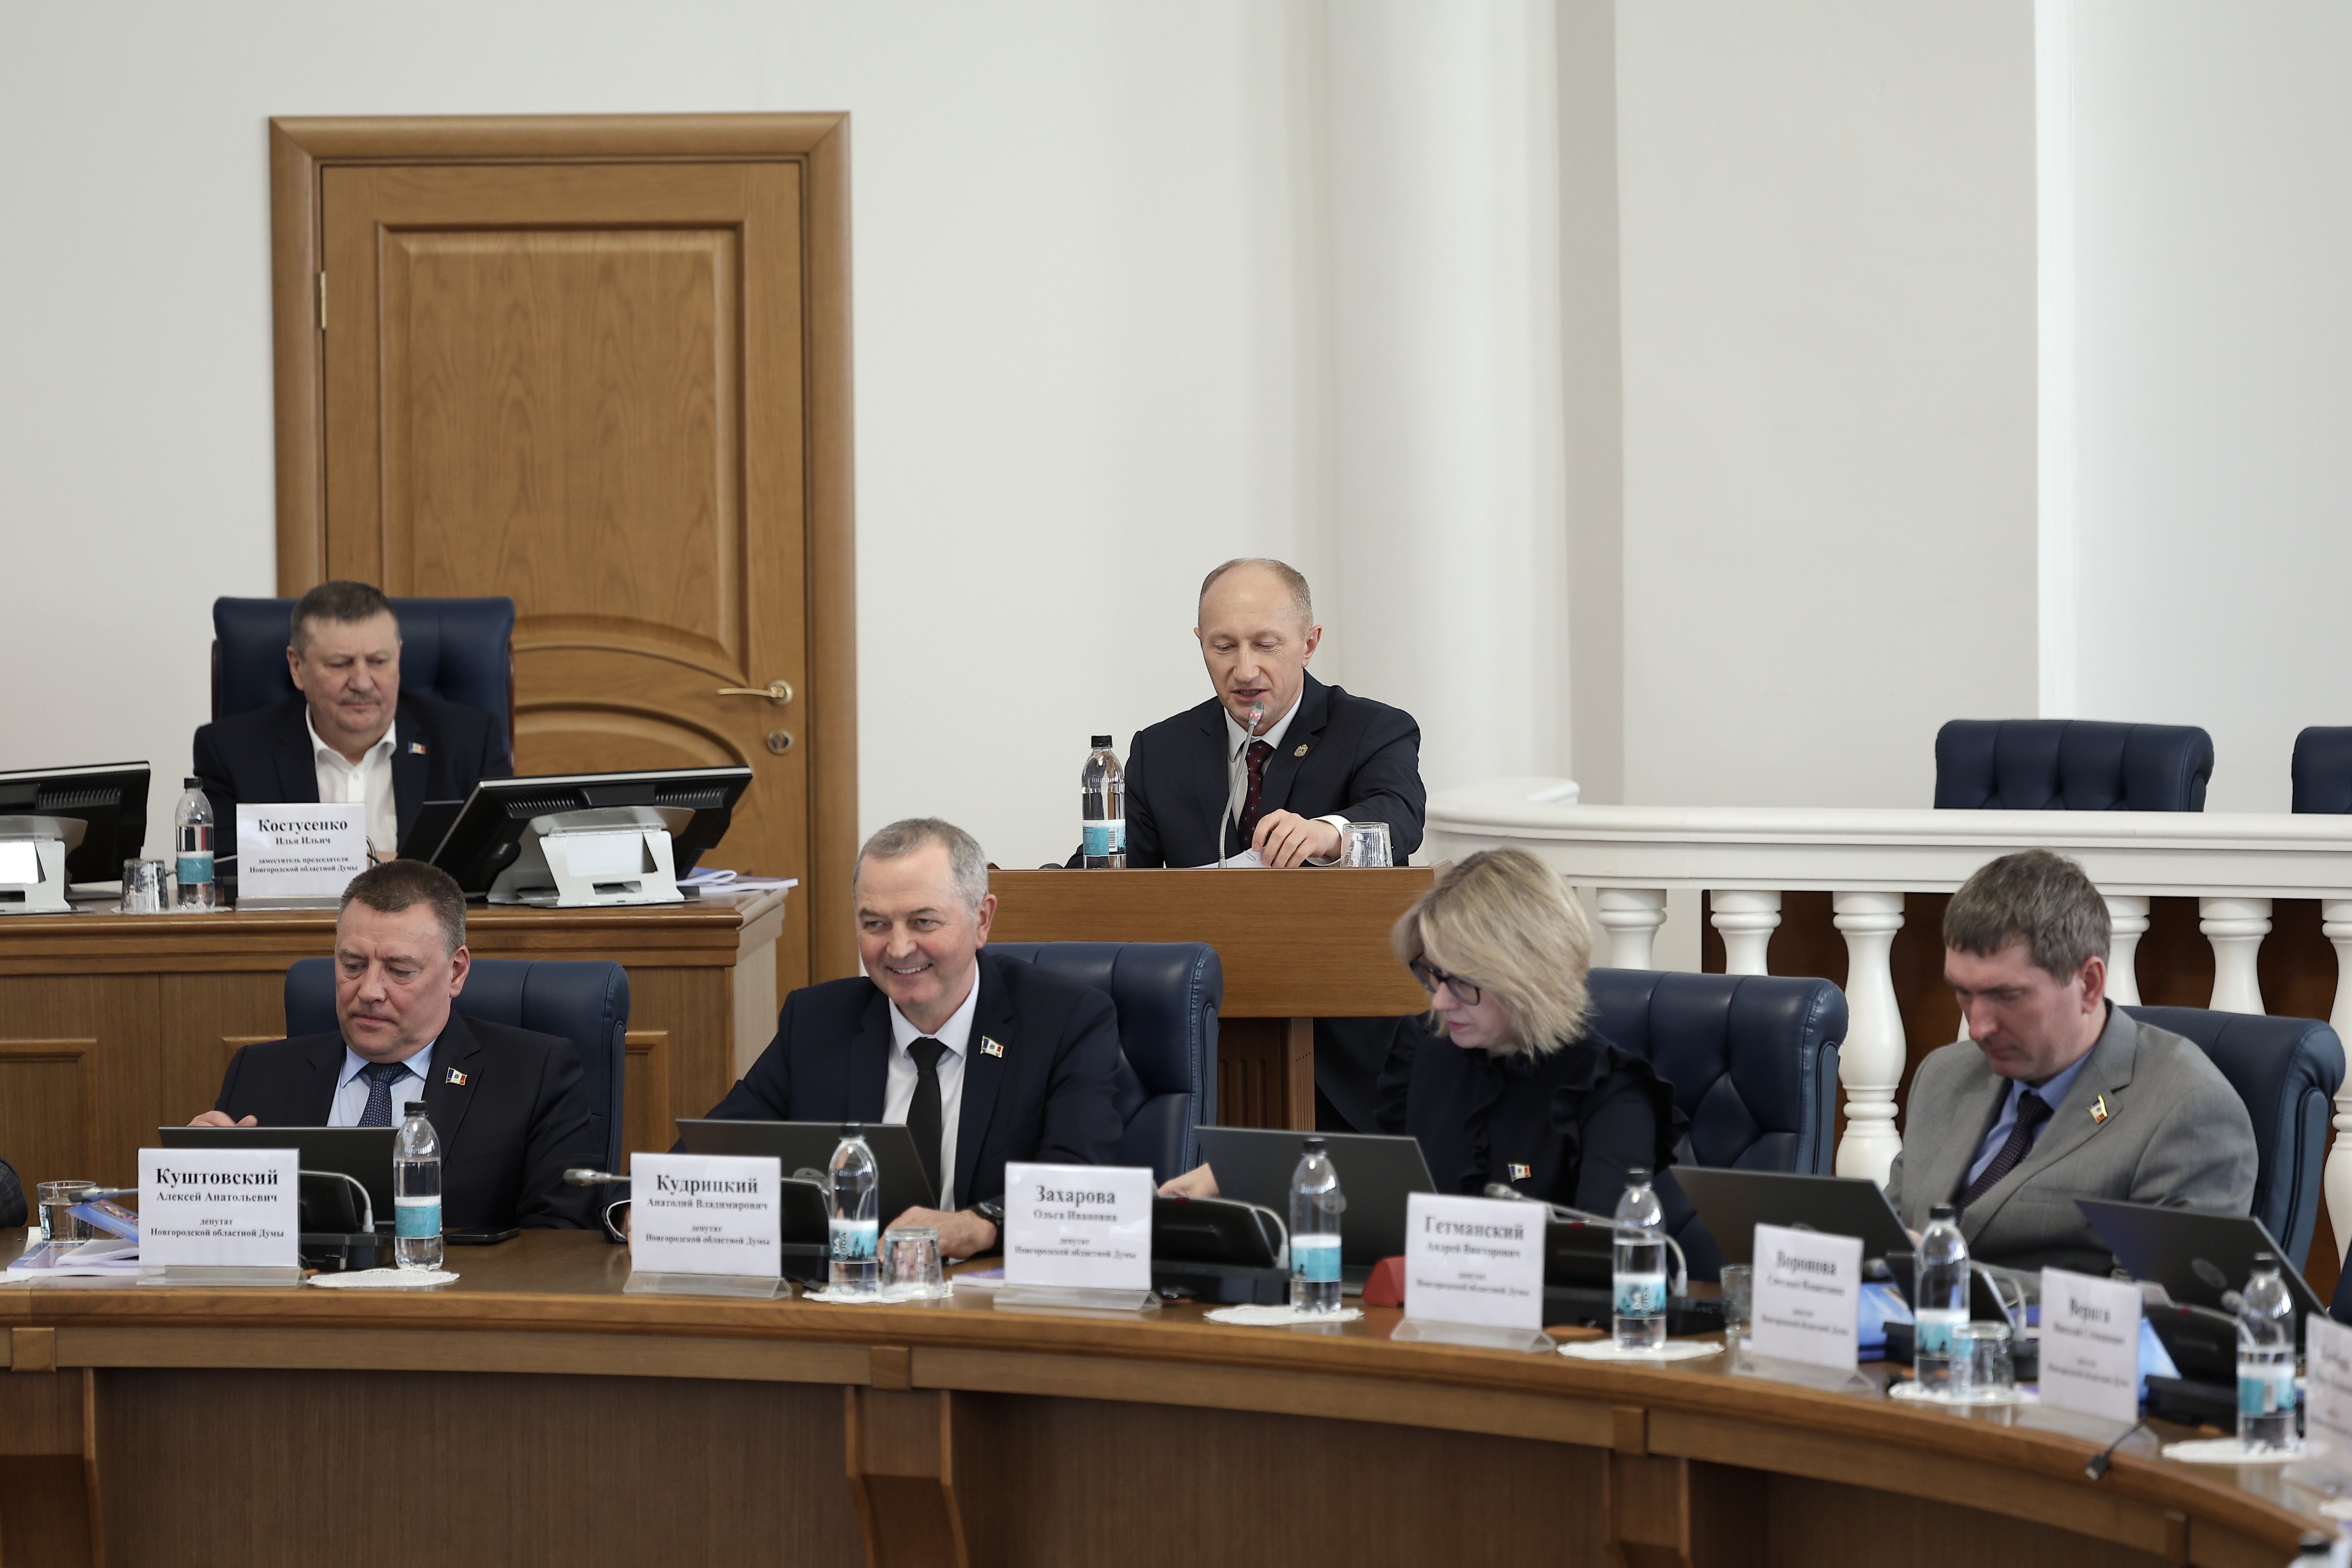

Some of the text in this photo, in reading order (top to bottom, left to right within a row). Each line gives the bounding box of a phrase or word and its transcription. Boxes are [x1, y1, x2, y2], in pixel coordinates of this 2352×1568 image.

[258, 819, 348, 835] Костусенко
[337, 864, 358, 873] Думы
[157, 1168, 278, 1189] Куштовский
[657, 1174, 757, 1196] Кудрицкий
[157, 1192, 277, 1202] Алексей Анатольевич
[1036, 1185, 1115, 1208] Захарова
[648, 1198, 768, 1212] Анатолий Владимирович
[151, 1227, 211, 1238] Новгородской
[258, 1229, 284, 1239] Думы
[691, 1226, 722, 1234] депутат
[1425, 1216, 1524, 1241] Гетманский
[646, 1234, 770, 1247] Новгородской областной Думы
